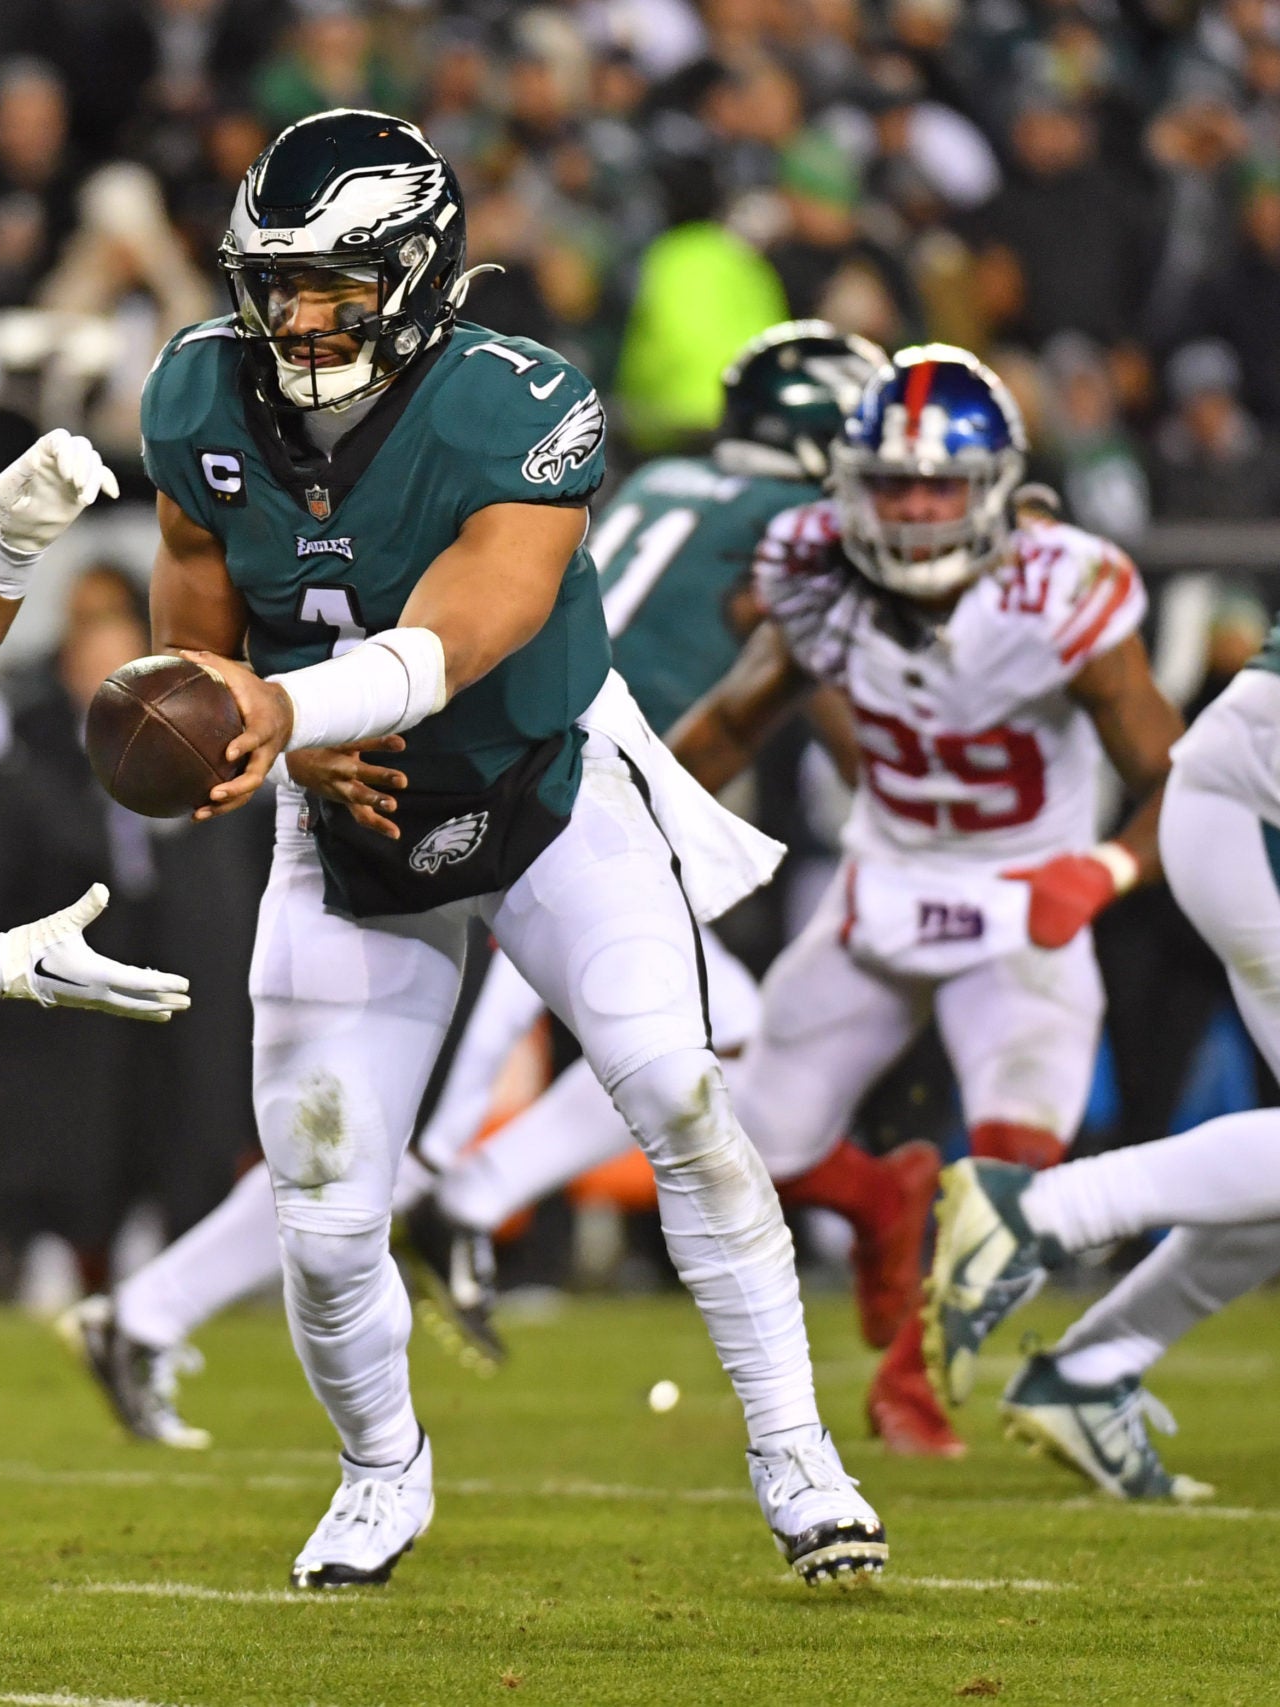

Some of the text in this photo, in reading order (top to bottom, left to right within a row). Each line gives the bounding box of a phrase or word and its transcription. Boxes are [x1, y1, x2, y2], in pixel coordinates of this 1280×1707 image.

[463, 342, 544, 375] 1
[201, 453, 243, 494] C
[296, 536, 354, 561] EAGLES
[853, 707, 1046, 833] 29
